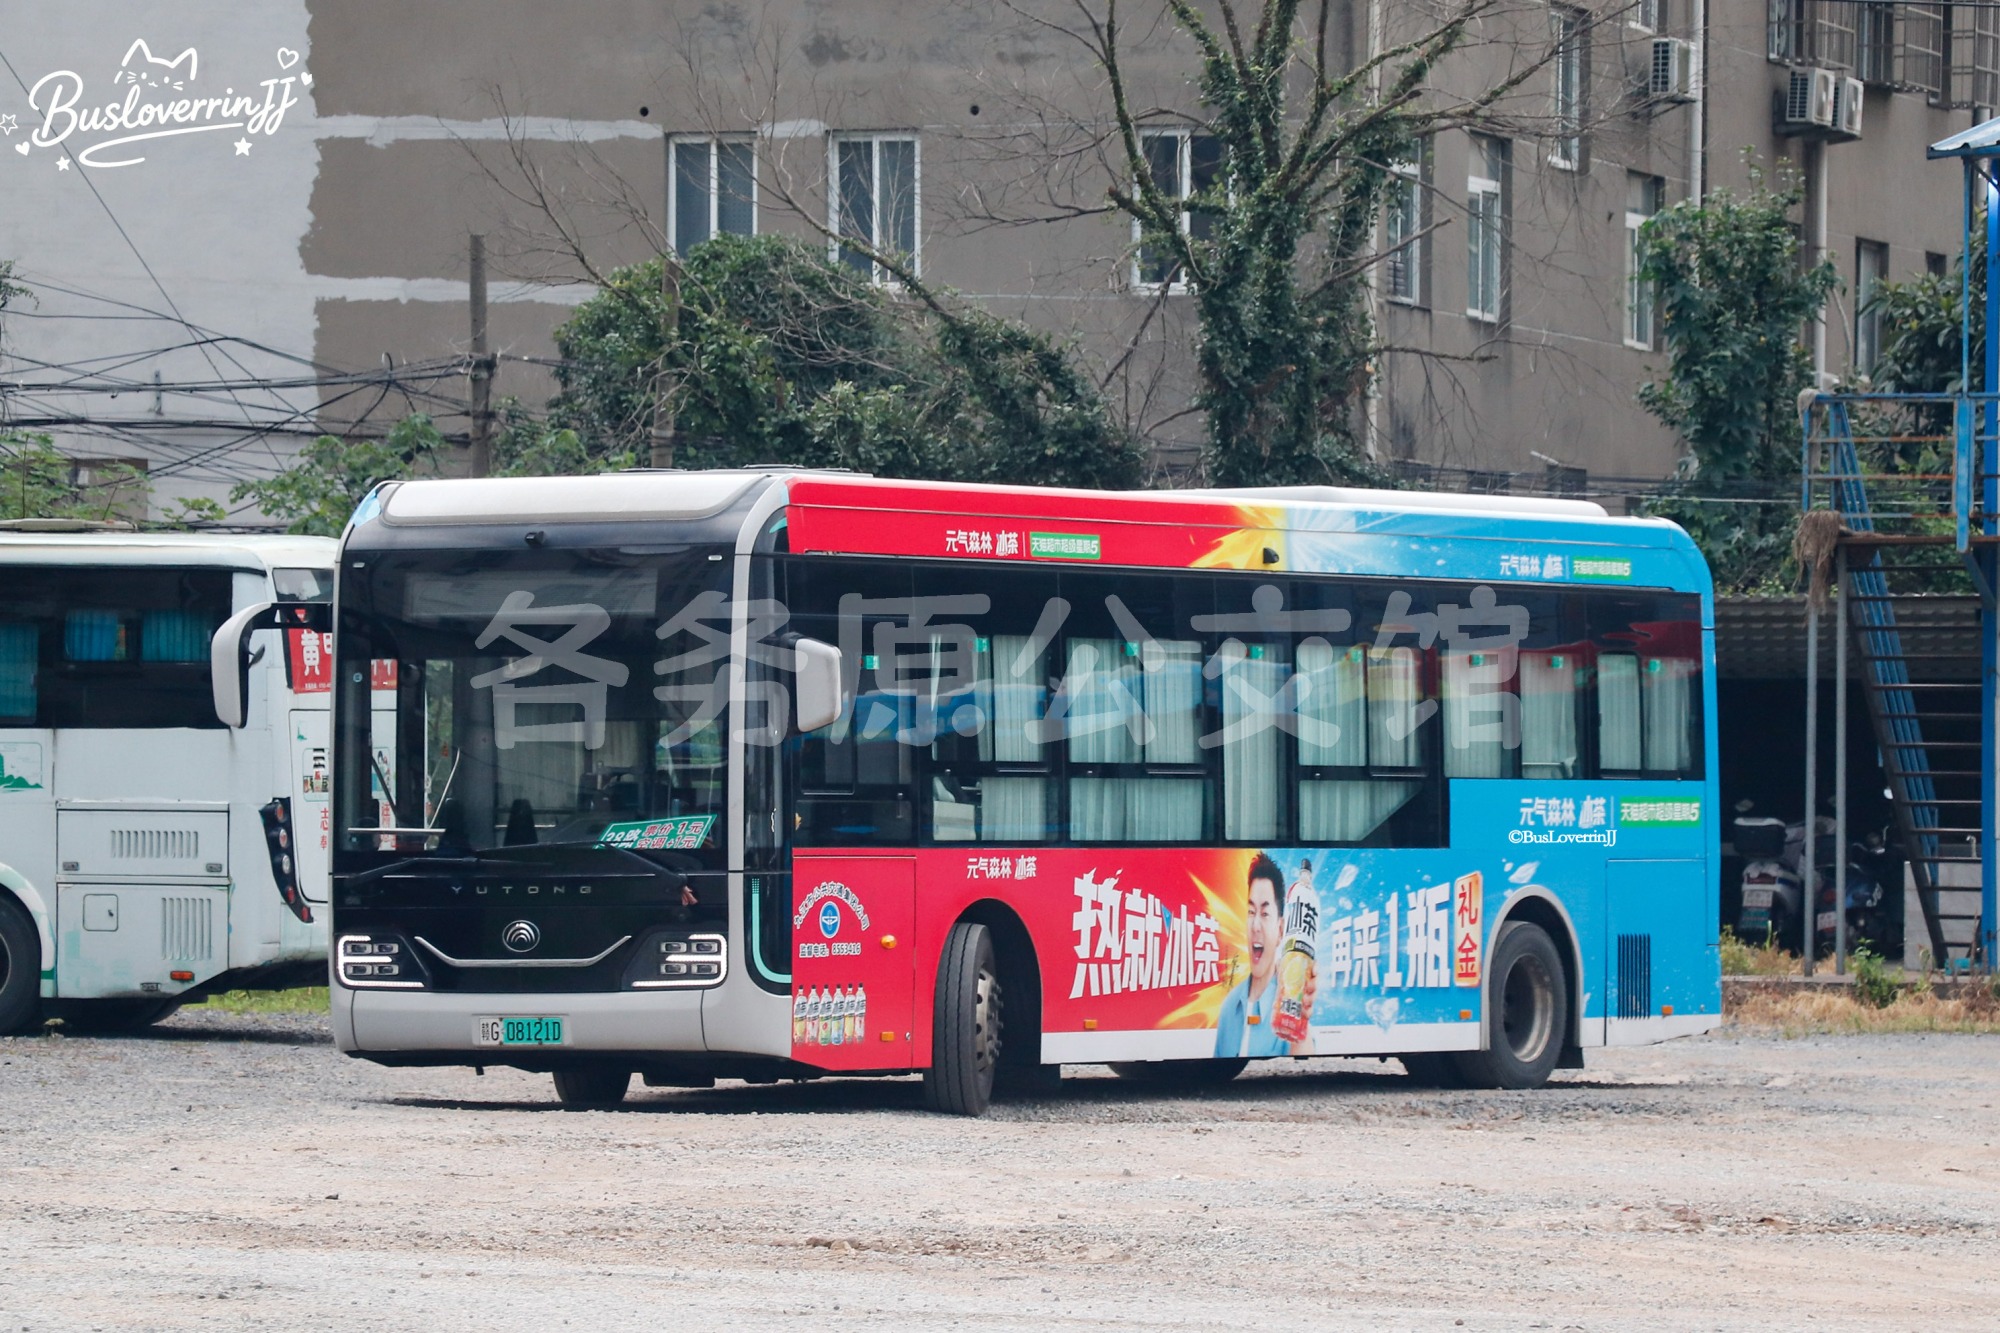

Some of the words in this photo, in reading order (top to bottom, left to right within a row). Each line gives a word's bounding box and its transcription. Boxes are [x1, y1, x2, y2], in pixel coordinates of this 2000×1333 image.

[945, 529, 993, 554] 元气森林
[995, 529, 1019, 557] 冰茶
[1500, 554, 1541, 577] 元气森林
[1520, 796, 1576, 827] 元气森林
[966, 856, 1012, 879] 元气森林
[1014, 855, 1037, 880] 冰茶
[451, 886, 593, 895] YUTONG
[1069, 868, 1220, 1000] 热就冰茶
[1330, 882, 1451, 988] 再来1瓶
[1457, 881, 1479, 979] 礼金
